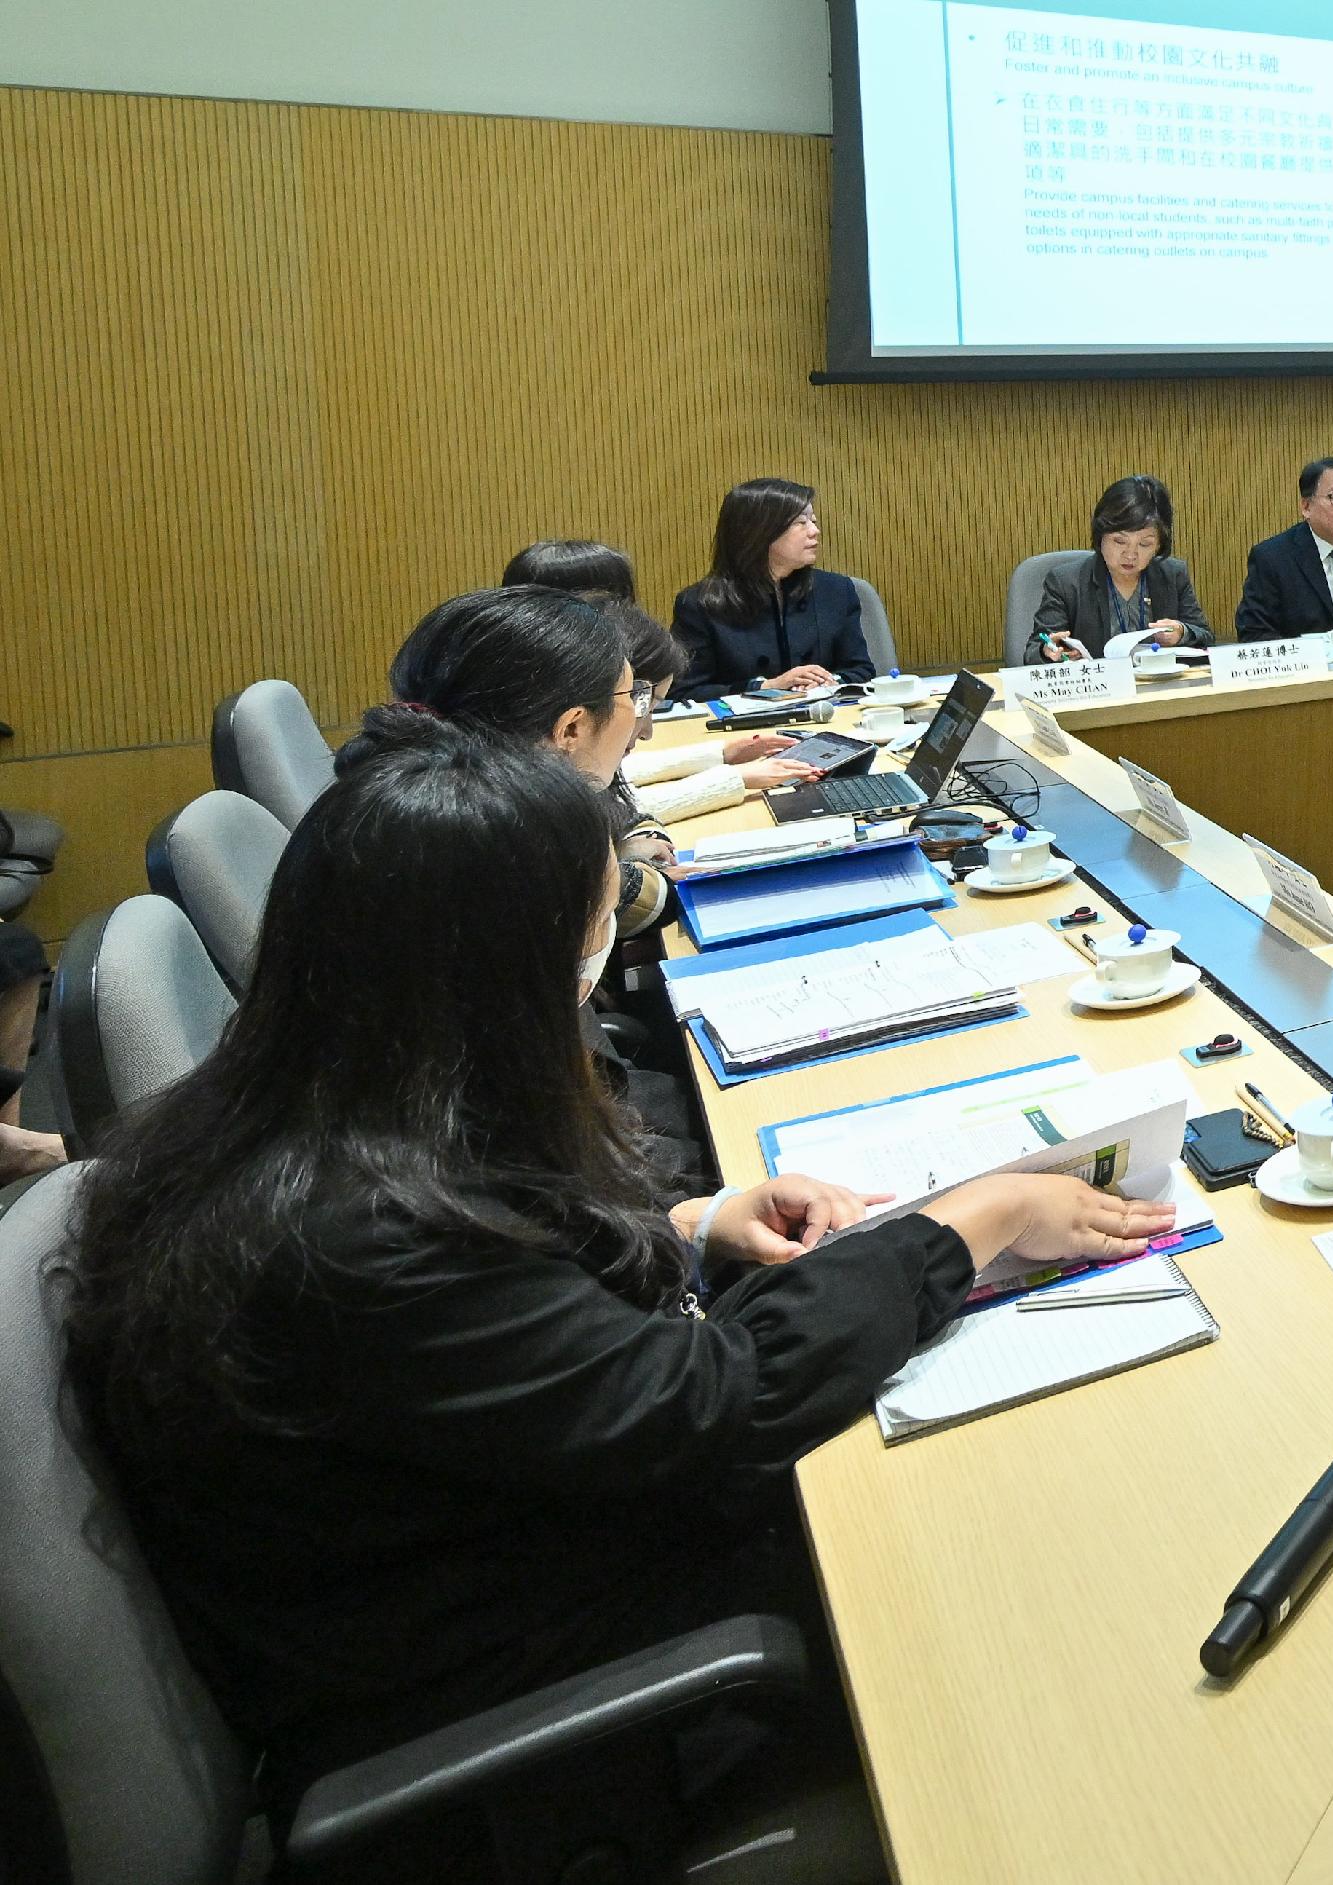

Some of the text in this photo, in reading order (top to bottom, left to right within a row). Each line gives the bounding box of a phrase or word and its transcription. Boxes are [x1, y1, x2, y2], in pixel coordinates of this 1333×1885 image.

[1004, 58, 1048, 73] Foster
[1054, 63, 1080, 76] and
[1084, 65, 1139, 81] promote
[1143, 72, 1160, 82] an
[1163, 73, 1218, 88] inclusive
[1222, 79, 1271, 93] campus
[1025, 188, 1078, 202] Provide
[1081, 192, 1134, 206] campus
[1138, 193, 1189, 206] facilities
[1193, 196, 1217, 208] and
[1221, 198, 1269, 212] catering
[1272, 201, 1320, 212] services
[1025, 207, 1067, 219] needs
[1071, 208, 1086, 219] of
[1215, 214, 1244, 226] such
[1248, 216, 1262, 226] as
[1025, 224, 1067, 237] toilets
[1071, 226, 1134, 241] equipped
[1136, 227, 1163, 239] with
[1167, 229, 1238, 244] appropriate
[1241, 231, 1288, 245] sanitary
[1026, 243, 1078, 257] options
[1081, 243, 1093, 255] in
[1097, 243, 1149, 258] catering
[1154, 245, 1197, 257] outlets
[1200, 248, 1215, 257] on
[1080, 663, 1105, 676] 女士
[1245, 664, 1272, 677] CHOI
[1033, 689, 1048, 699] Ms
[1050, 687, 1072, 698] May
[1075, 681, 1108, 694] CHAN
